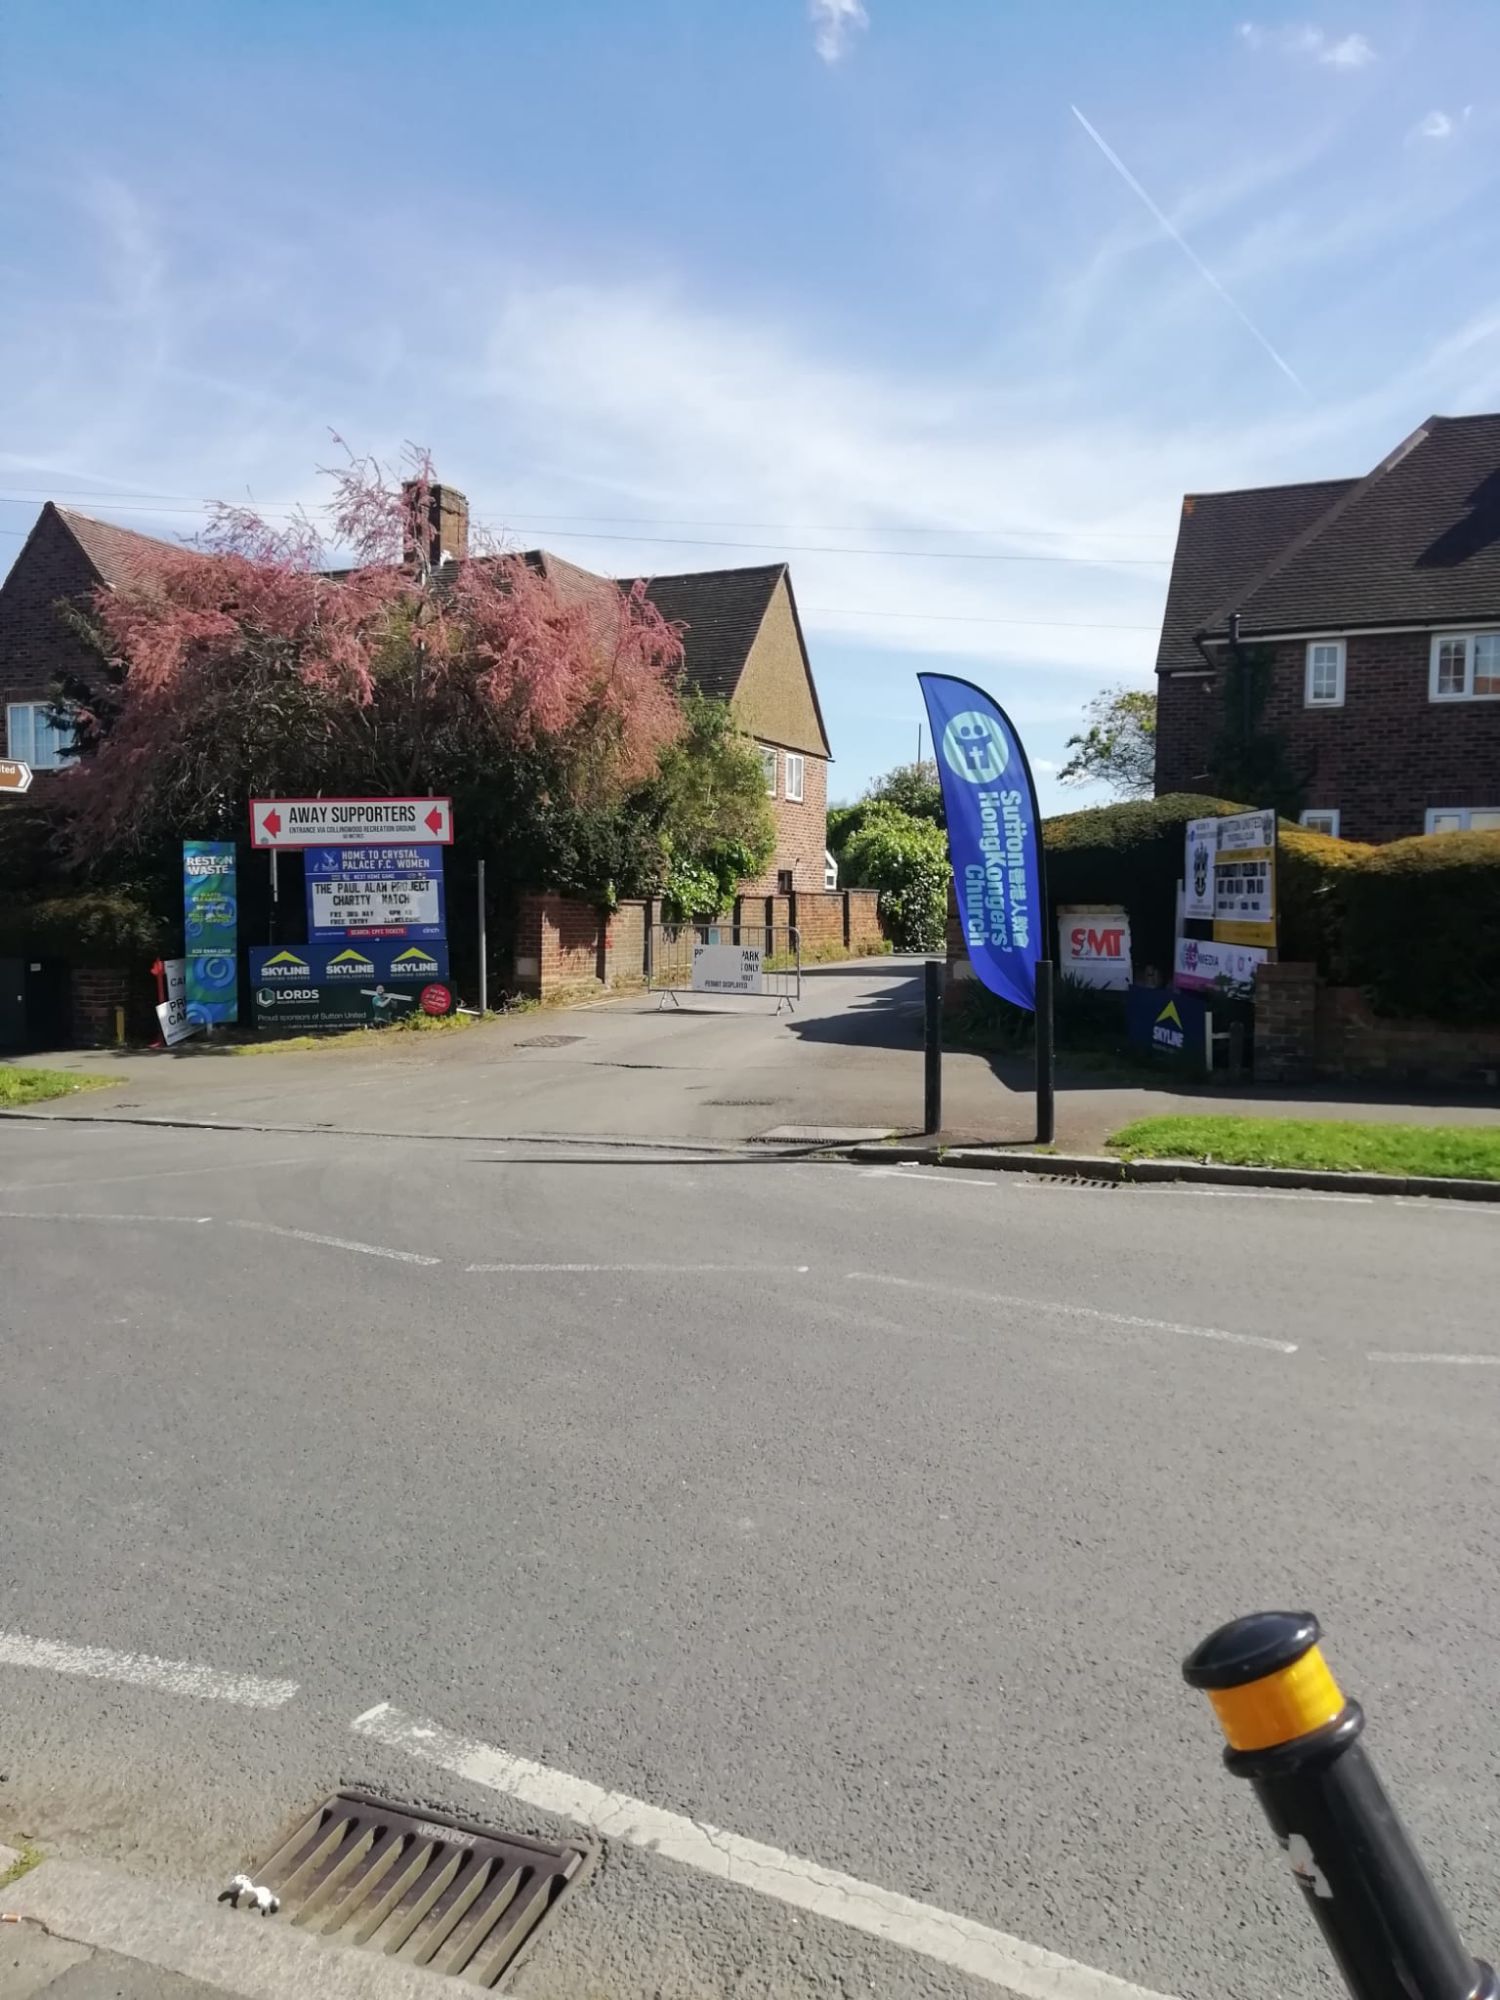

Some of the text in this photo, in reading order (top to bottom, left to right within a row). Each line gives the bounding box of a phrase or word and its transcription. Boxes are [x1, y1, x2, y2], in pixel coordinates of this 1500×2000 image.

[0, 764, 16, 774] ted
[289, 805, 416, 823] AWAY SUPPORTERS
[289, 826, 316, 834] ENTRANCE
[1001, 790, 1028, 866] Sutton
[342, 849, 419, 860] HOME TO CRYSTAL
[342, 858, 430, 870] PALACE F.C. WOMEN
[188, 865, 229, 875] WASTE
[315, 883, 332, 894] THE
[337, 882, 361, 894] PAUL
[332, 893, 410, 906] CHARITY MATCH
[964, 864, 991, 946] Church
[1071, 928, 1125, 957] SMT
[261, 966, 310, 976] SKYLINE
[326, 964, 375, 974] SKYLINE
[390, 962, 439, 973] SKYLINE
[744, 963, 760, 972] ONLY
[276, 989, 320, 1000] LORDS
[257, 1014, 279, 1022] Proud
[280, 1014, 311, 1023] sponsors
[320, 1012, 343, 1020] Sutton
[344, 1011, 367, 1019] United
[1152, 1025, 1184, 1048] SKYLINE
